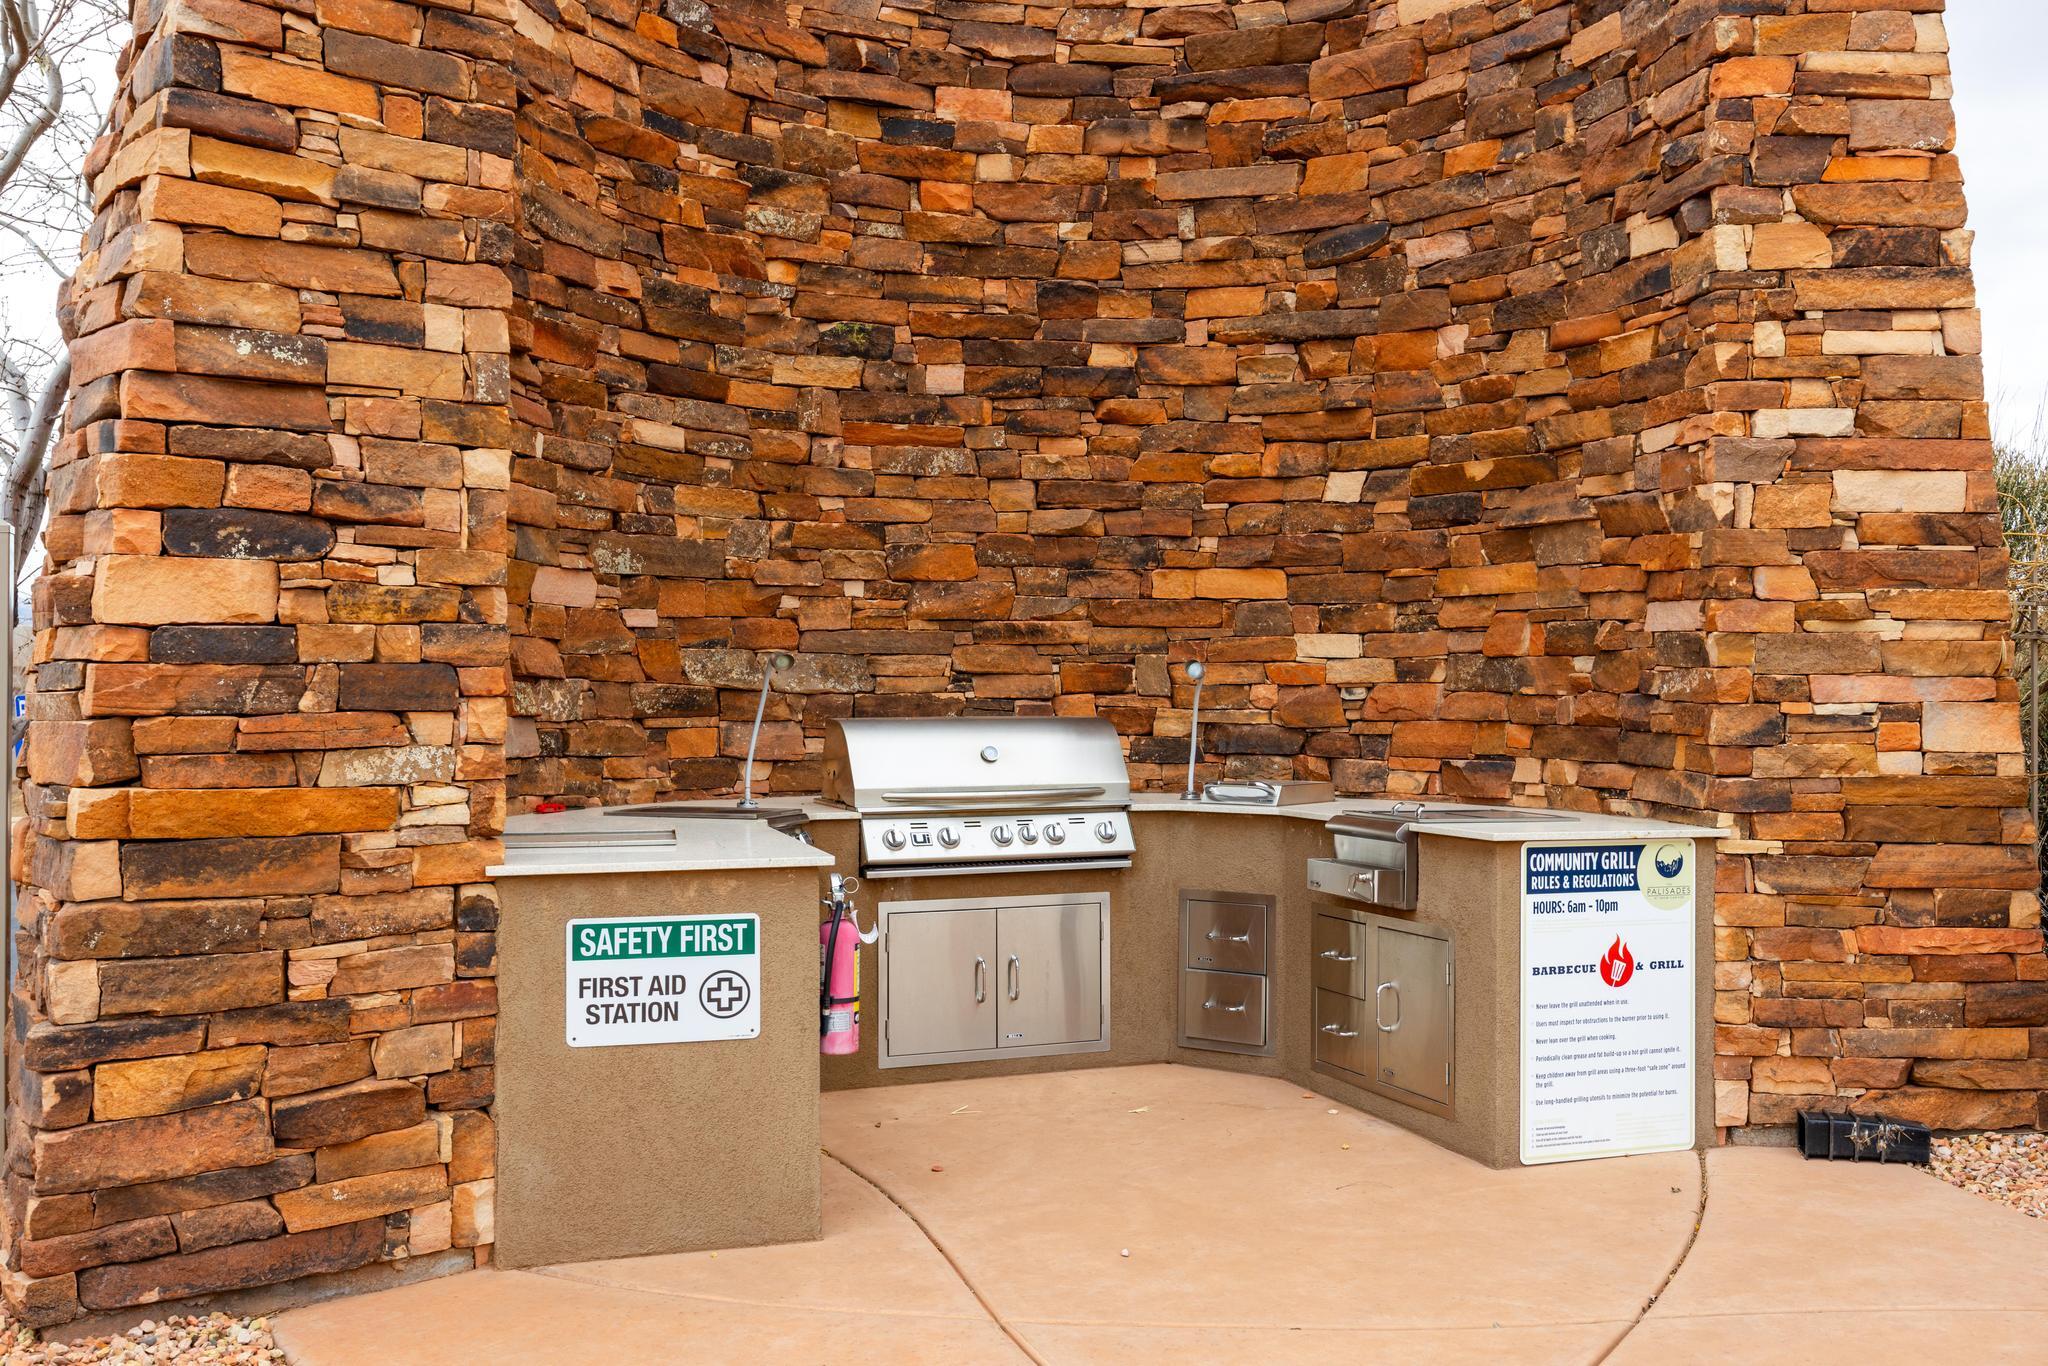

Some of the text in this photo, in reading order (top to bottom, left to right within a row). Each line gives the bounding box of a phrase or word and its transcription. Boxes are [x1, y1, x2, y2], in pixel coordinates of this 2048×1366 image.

[1530, 851, 1636, 871] COMMUNITY GRILL
[1531, 873, 1635, 890] RULES & REGULATIONS
[1647, 886, 1691, 896] PALISADES
[1533, 900, 1565, 914] HOURS:
[1567, 900, 1586, 913] 6am
[1595, 898, 1618, 914] 10pm
[580, 924, 747, 957] SAFETY FIRST
[1532, 960, 1684, 976] BARBECUE & GRILL
[579, 974, 686, 998] FIRST AID
[586, 1001, 679, 1025] STATION
[1560, 1019, 1574, 1027] inspect
[1544, 1097, 1572, 1105] long-handled
[1639, 1090, 1657, 1098] potential
